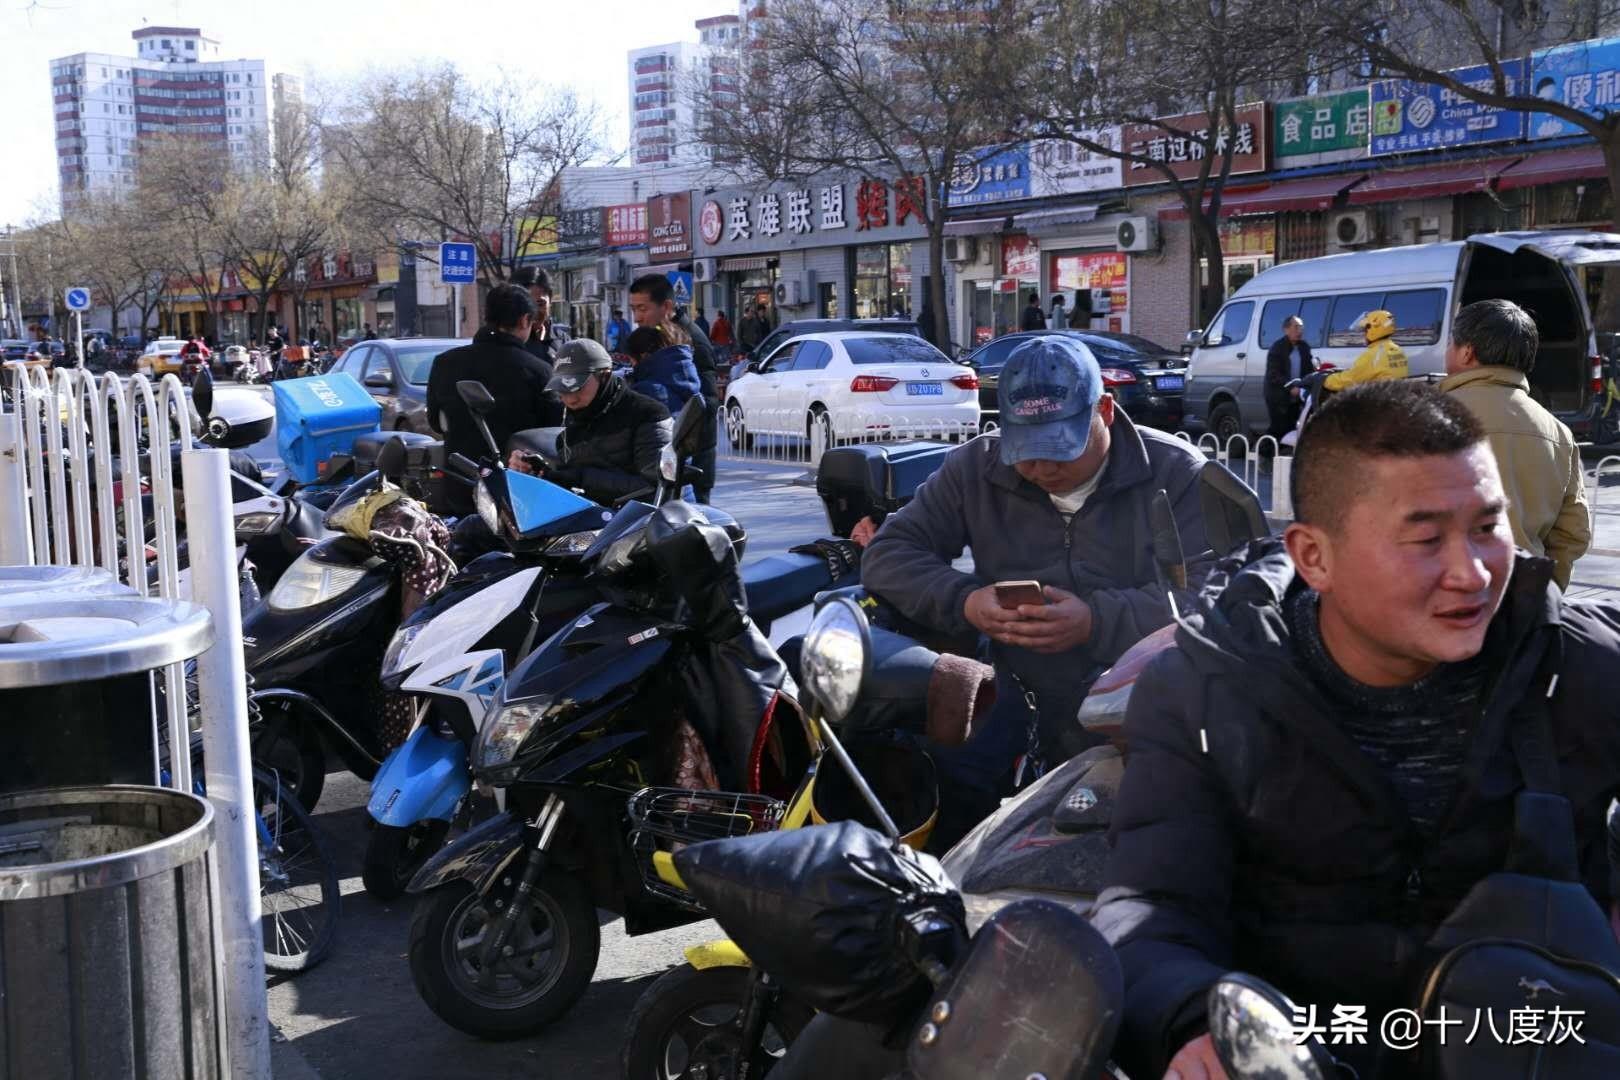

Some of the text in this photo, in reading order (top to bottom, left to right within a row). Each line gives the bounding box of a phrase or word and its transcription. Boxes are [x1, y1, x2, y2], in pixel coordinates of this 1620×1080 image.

[1280, 105, 1369, 143] 食品店
[1442, 108, 1473, 119] China
